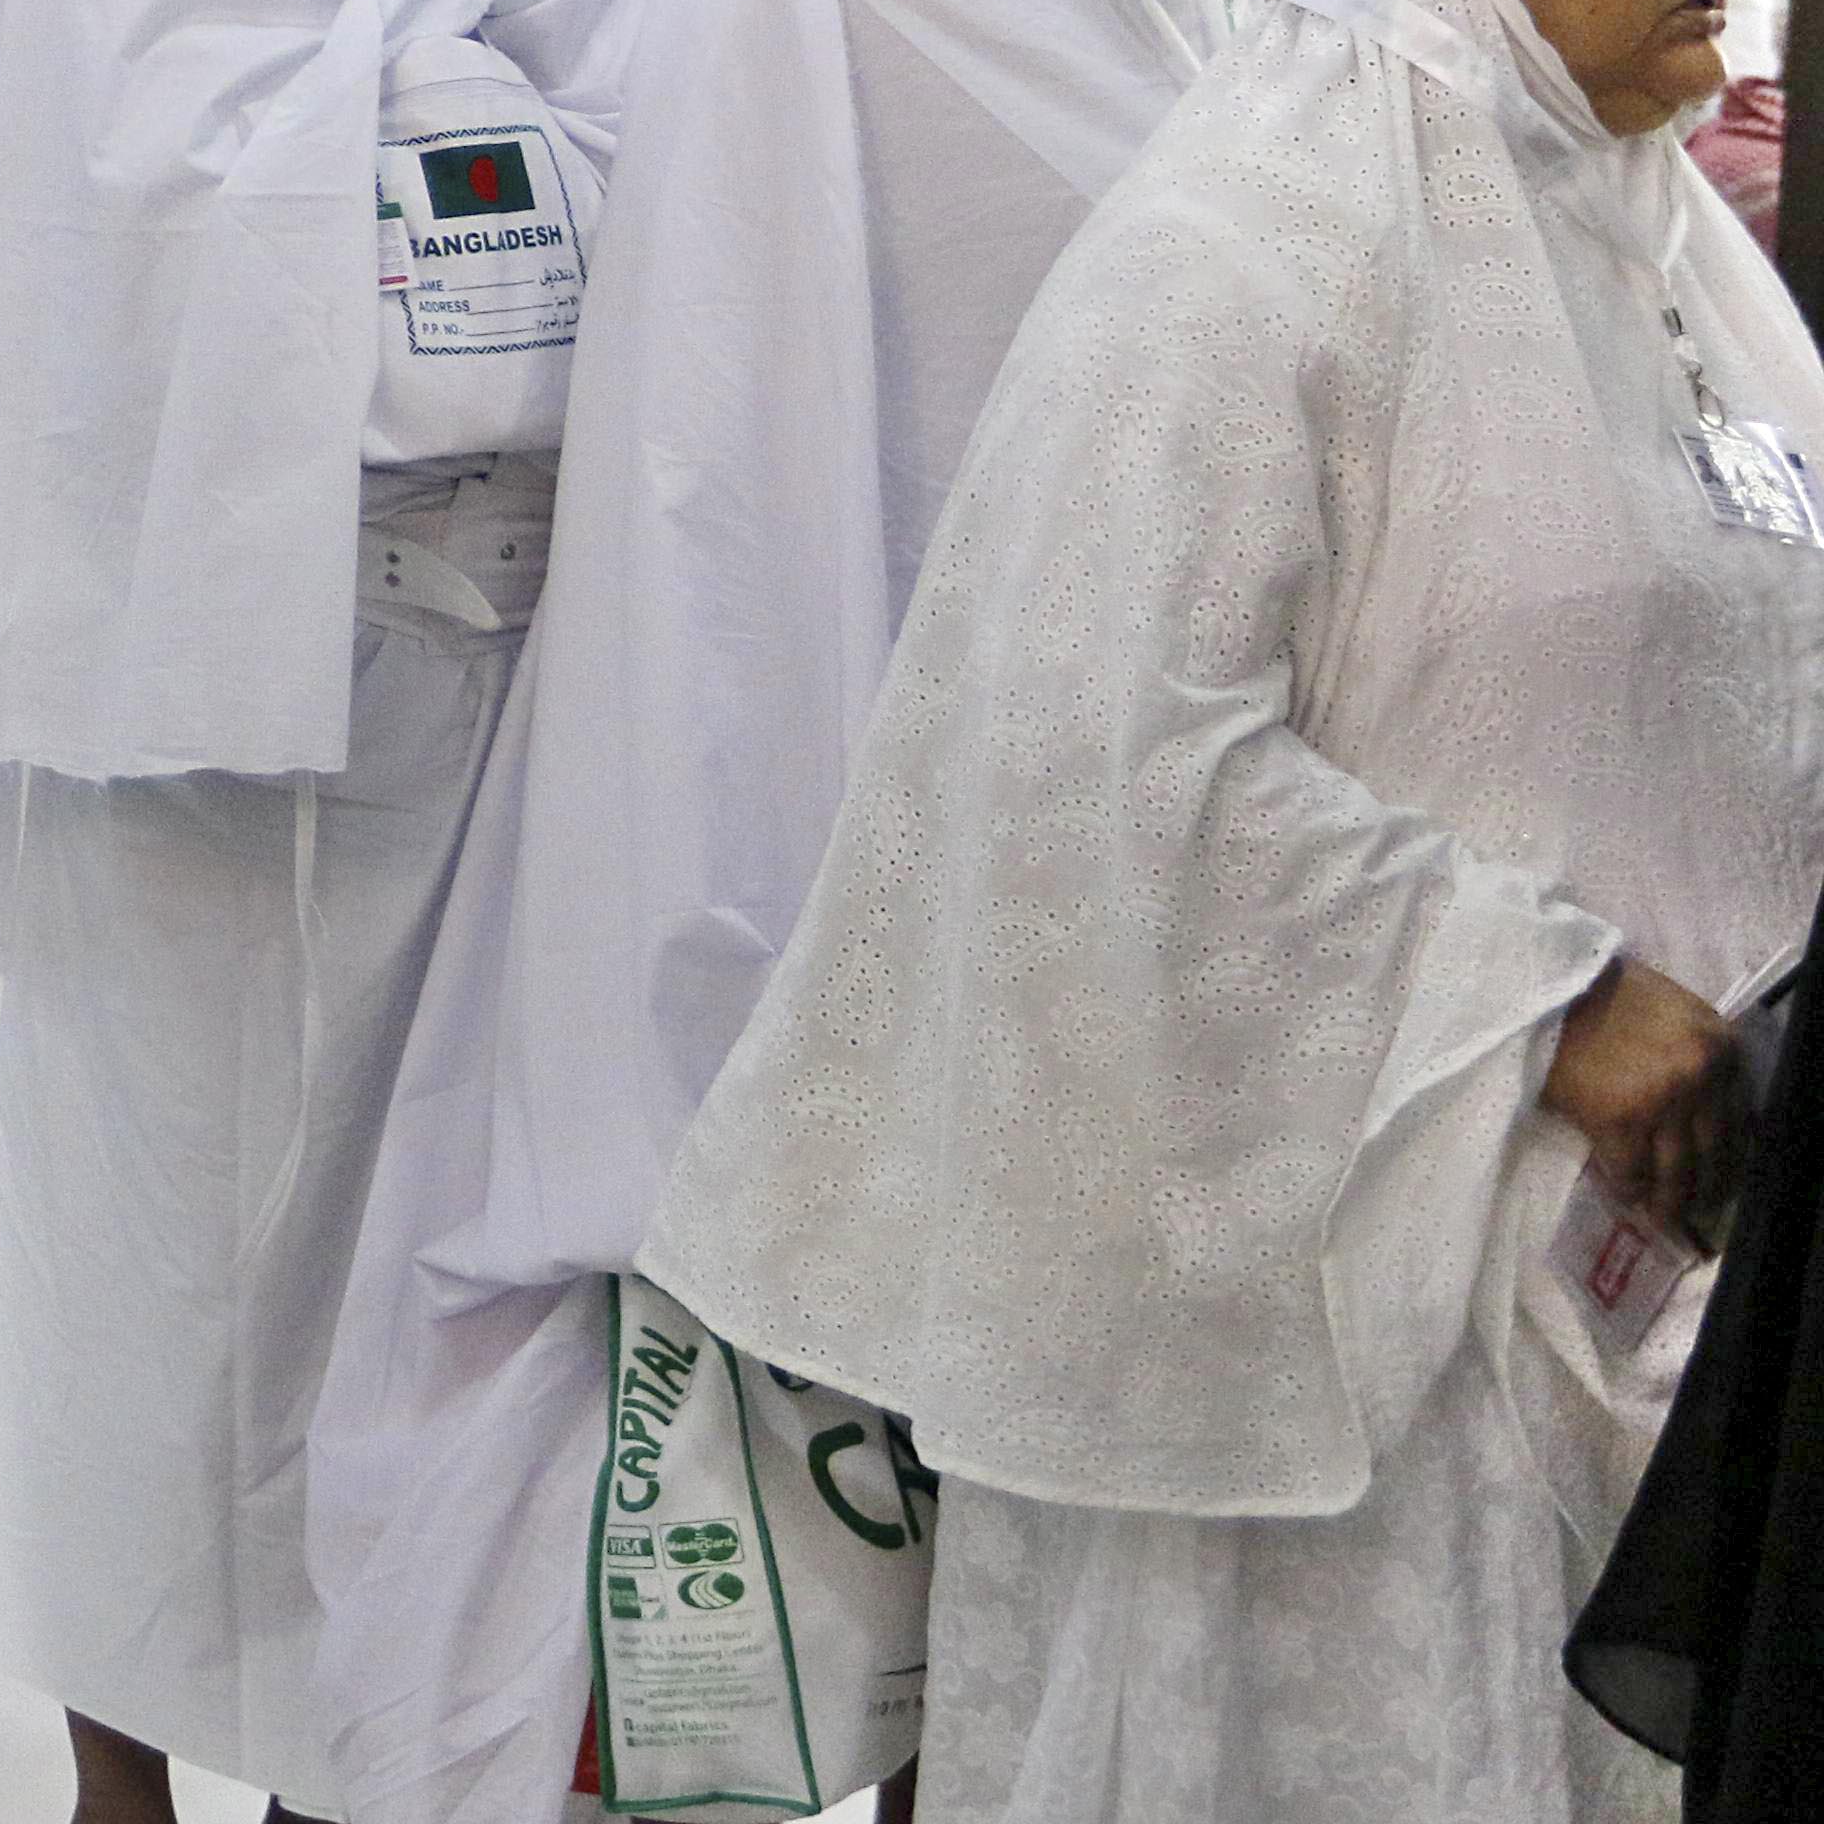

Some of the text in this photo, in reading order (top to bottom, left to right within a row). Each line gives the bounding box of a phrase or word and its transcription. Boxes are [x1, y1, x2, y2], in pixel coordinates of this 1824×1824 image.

[416, 279, 444, 292] AME
[419, 299, 471, 313] ADDRESS
[616, 1326, 699, 1513] CAPITAL
[609, 1538, 642, 1555] VISA
